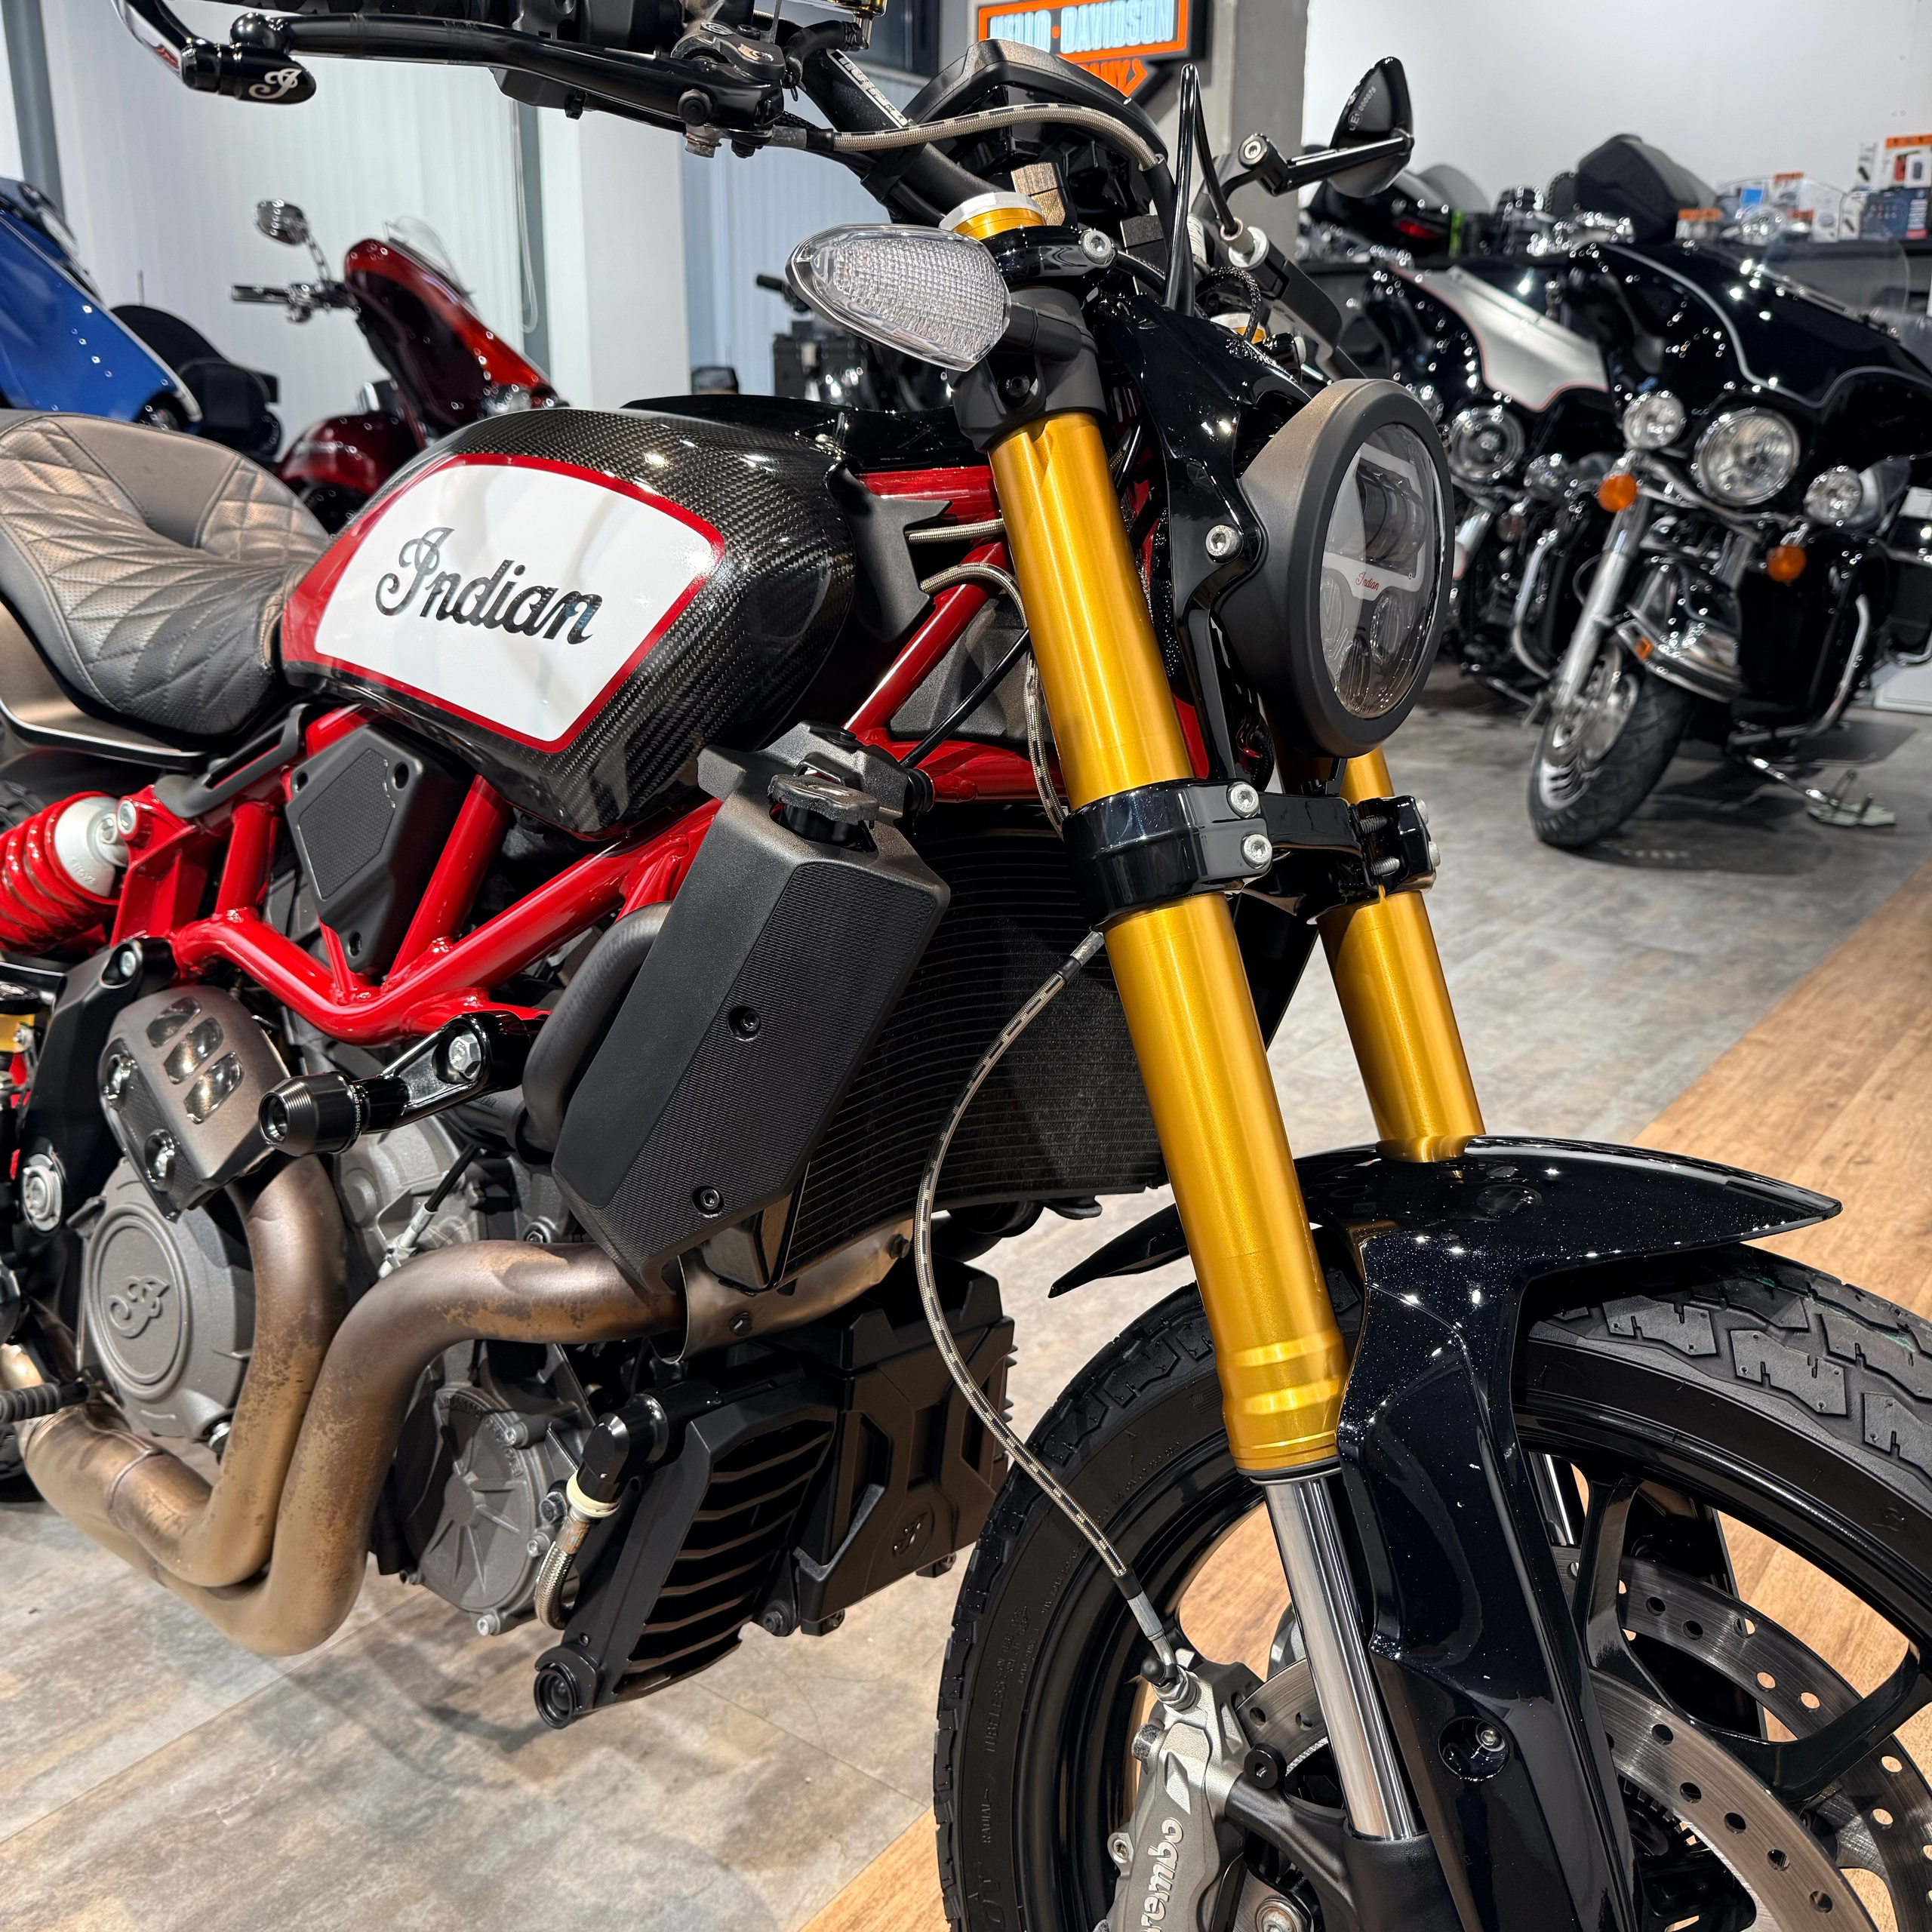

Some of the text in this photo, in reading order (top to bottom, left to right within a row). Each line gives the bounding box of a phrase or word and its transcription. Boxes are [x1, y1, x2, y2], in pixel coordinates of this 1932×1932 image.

[1060, 0, 1174, 54] DAVIDSON
[375, 527, 603, 645] Indian
[1355, 571, 1380, 591] Indian
[984, 1680, 1008, 1753] TUBELESS
[981, 1804, 992, 1844] RADIAL
[1140, 1817, 1183, 1932] rembo
